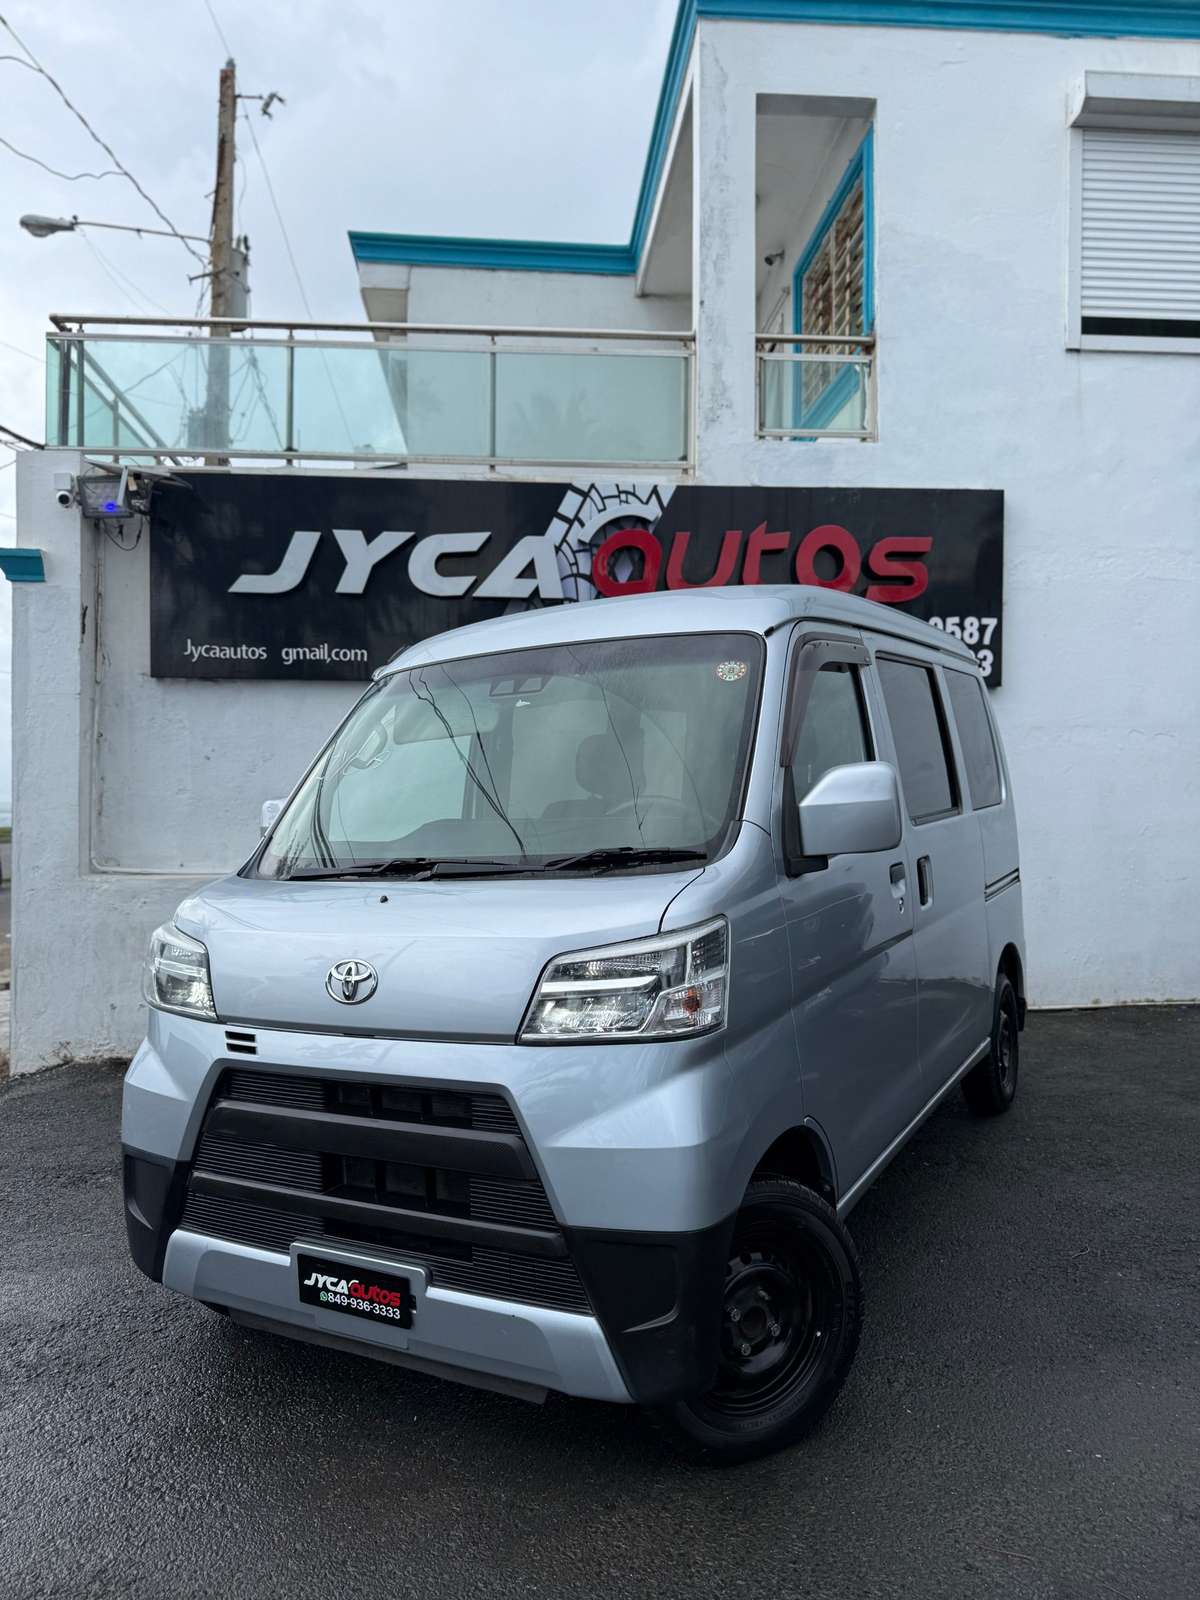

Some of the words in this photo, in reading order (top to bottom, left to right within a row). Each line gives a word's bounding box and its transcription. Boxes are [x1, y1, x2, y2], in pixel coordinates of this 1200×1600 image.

[227, 529, 565, 599] JYCA
[184, 638, 268, 662] Jycaautos
[303, 1272, 349, 1295] JYCA
[327, 1292, 401, 1320] 849-936-3333
